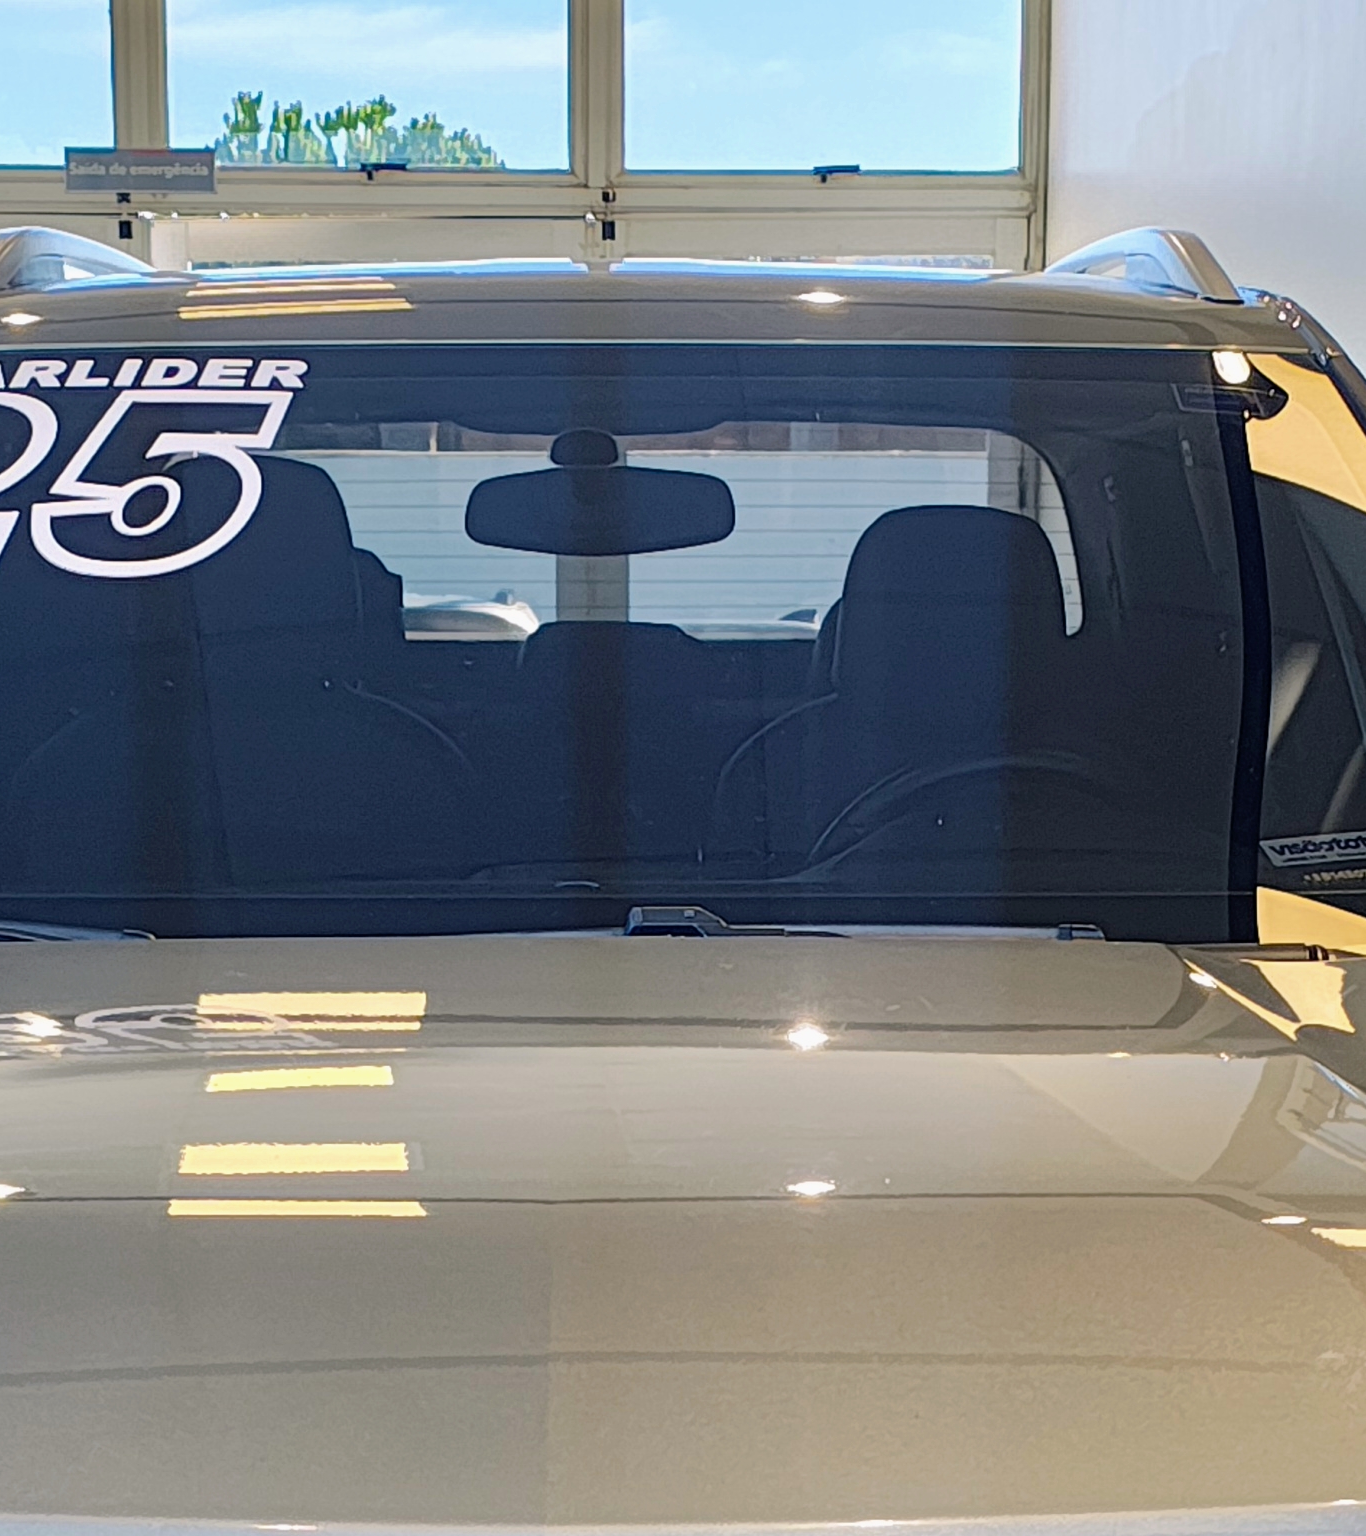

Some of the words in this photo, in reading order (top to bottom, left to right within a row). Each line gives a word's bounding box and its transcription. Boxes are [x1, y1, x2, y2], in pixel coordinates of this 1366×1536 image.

[69, 161, 106, 175] Saída
[109, 162, 126, 175] de
[130, 161, 209, 178] emergência
